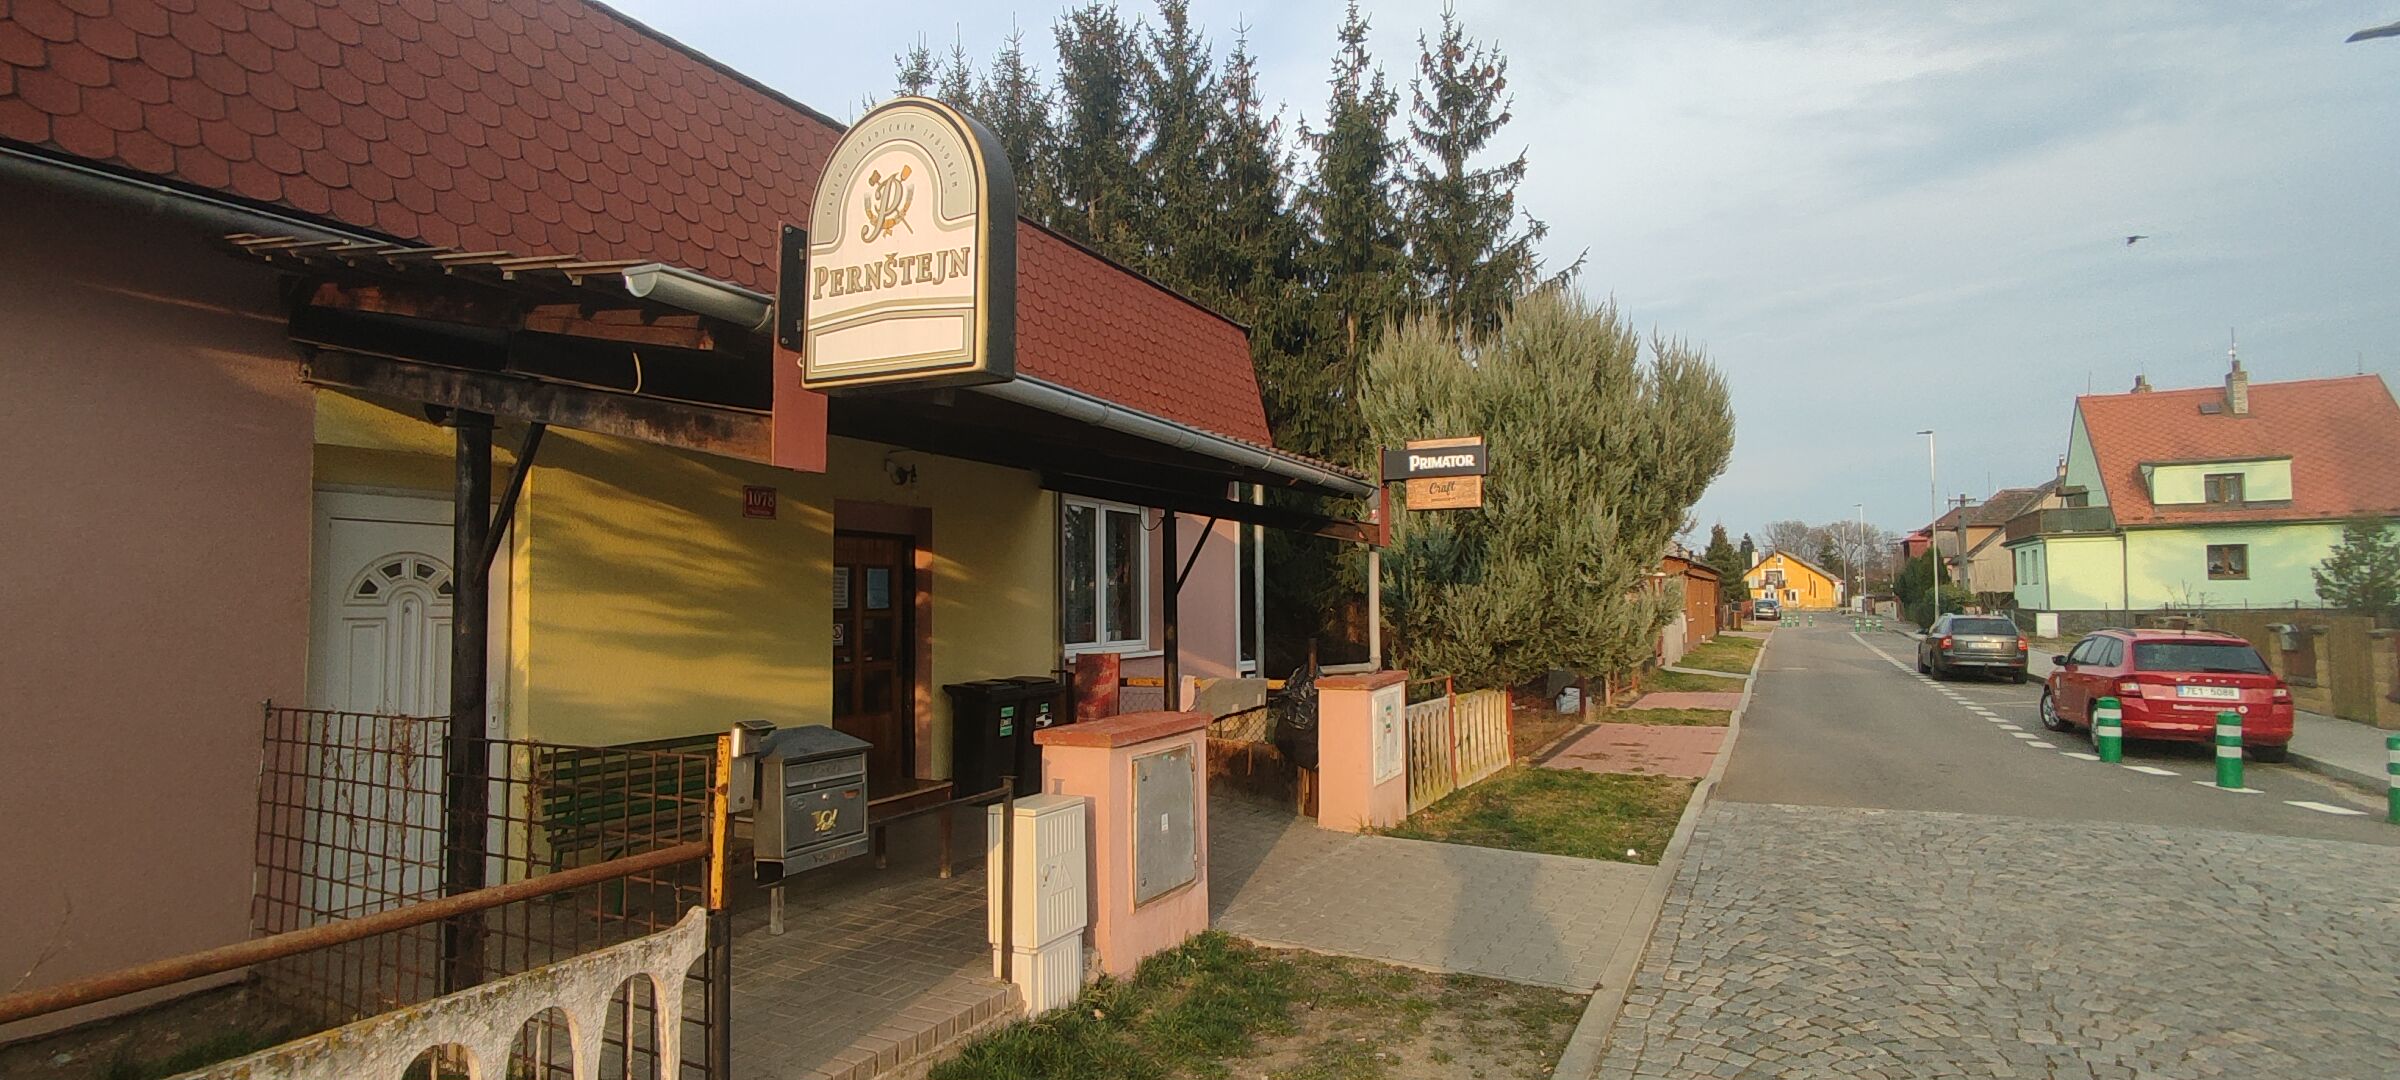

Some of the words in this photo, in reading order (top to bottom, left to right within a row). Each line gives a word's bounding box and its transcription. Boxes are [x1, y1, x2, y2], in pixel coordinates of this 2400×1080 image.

[812, 246, 971, 300] PERNŠTEJN
[1409, 455, 1475, 472] PRIMATOR
[1429, 481, 1456, 496] Craft
[747, 490, 775, 508] 1078
